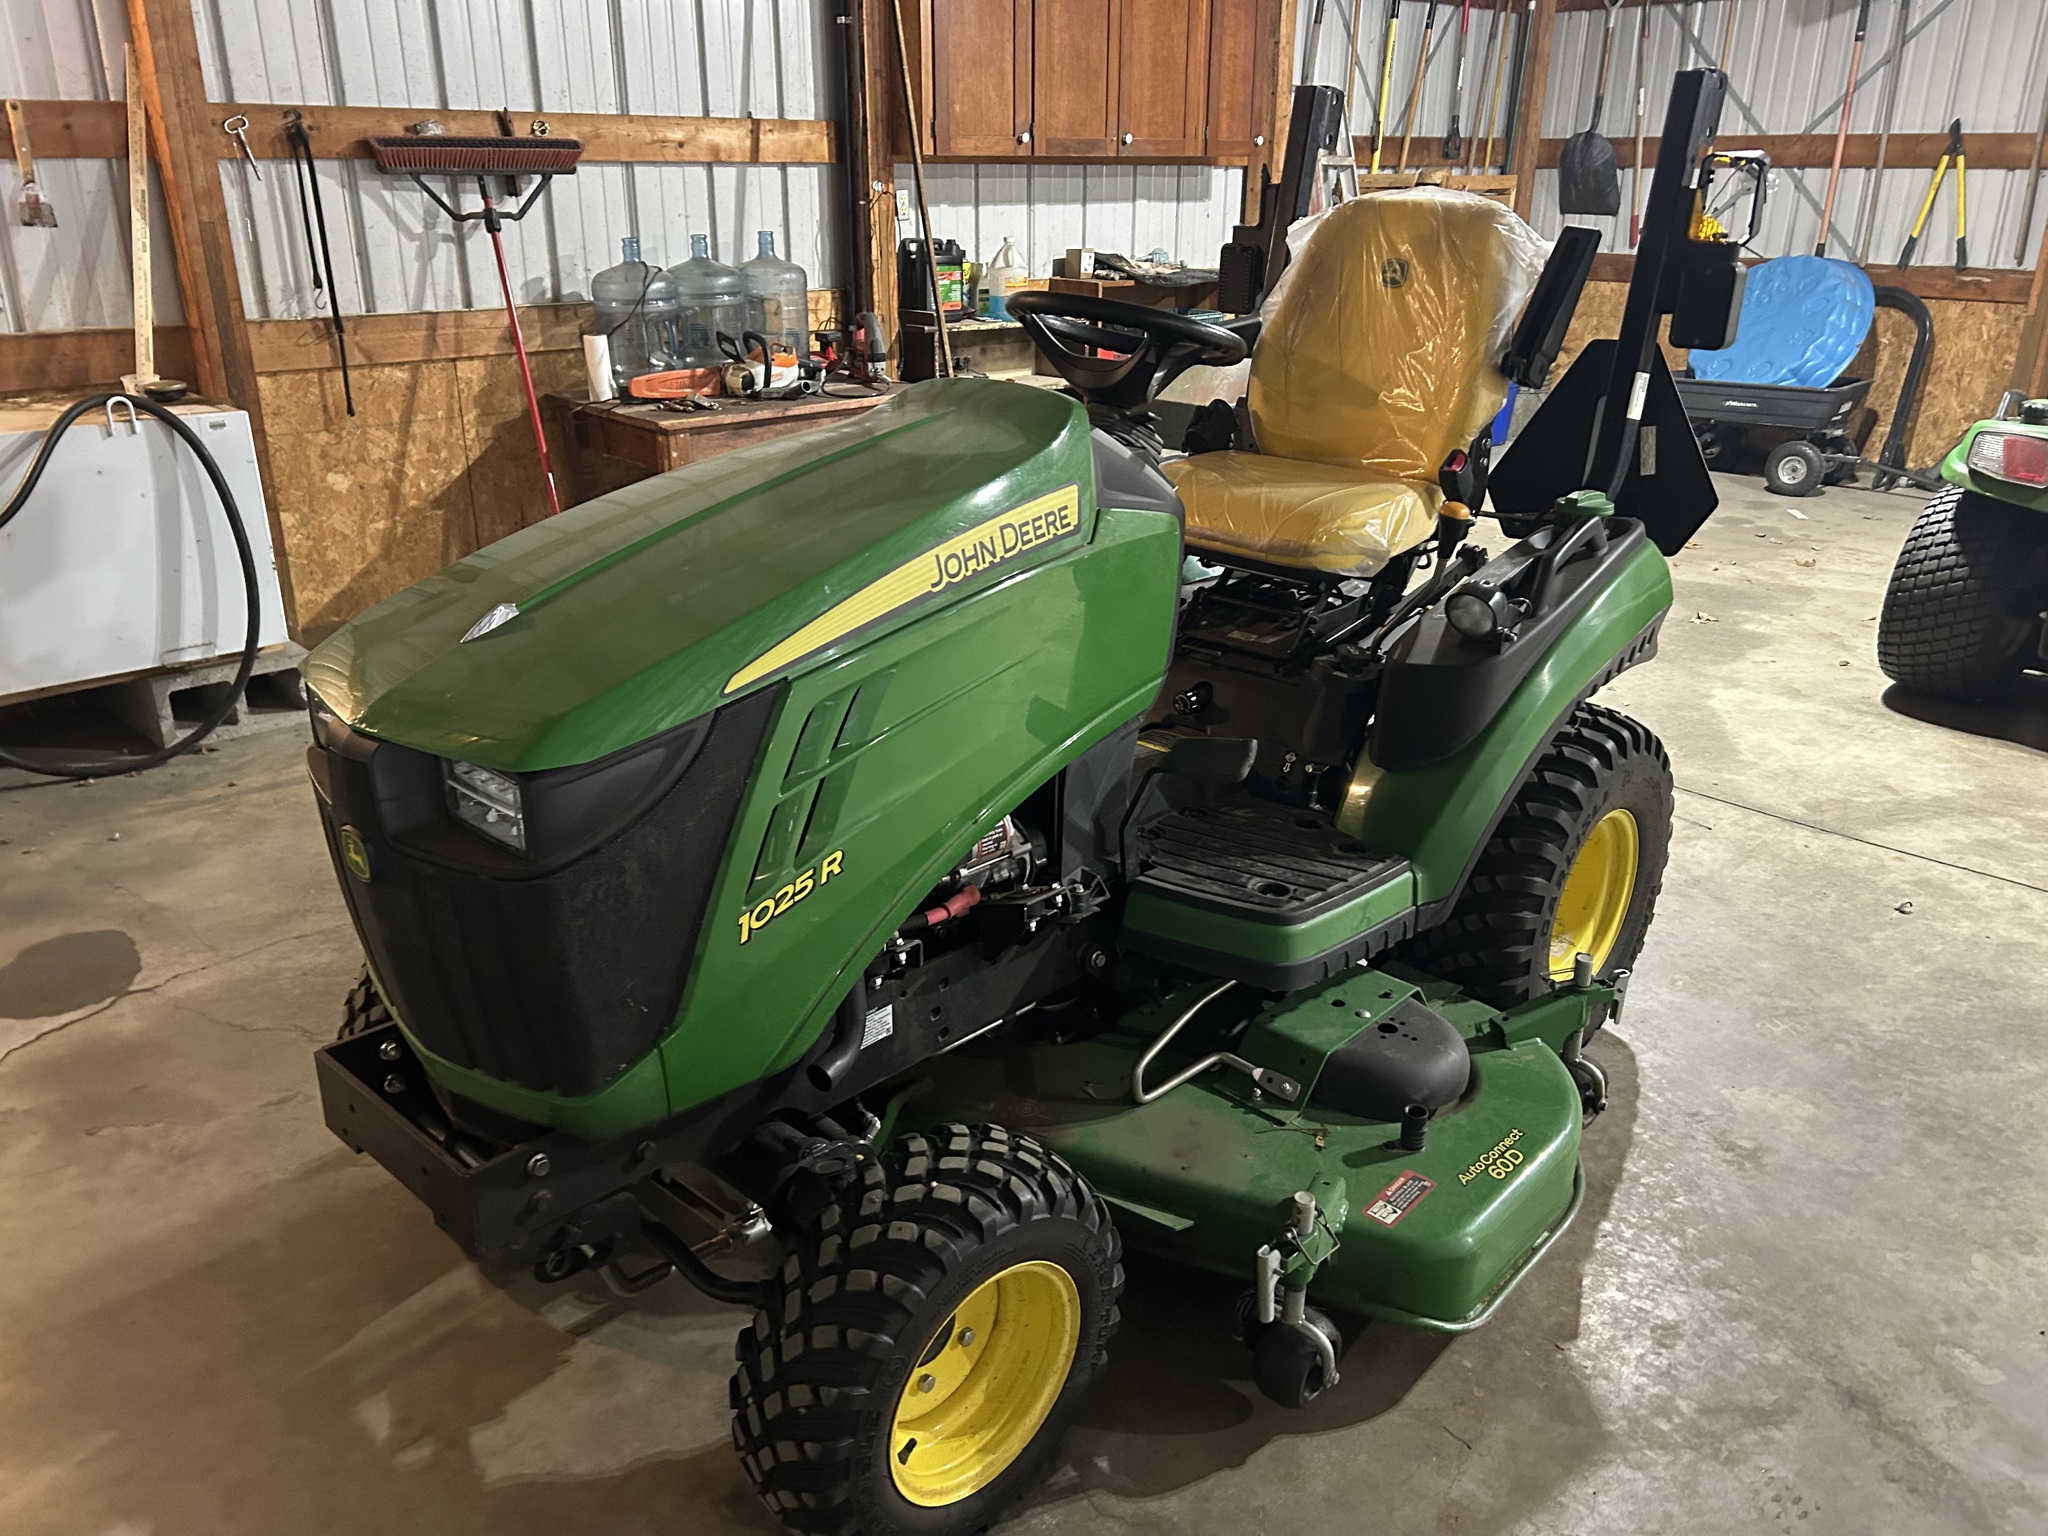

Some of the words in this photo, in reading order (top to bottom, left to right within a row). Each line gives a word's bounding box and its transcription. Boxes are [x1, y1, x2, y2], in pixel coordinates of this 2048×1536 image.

[930, 536, 998, 589] JOHN
[999, 505, 1072, 554] DEERE
[1457, 1128, 1524, 1185] AutoConnect
[1487, 1149, 1525, 1180] 60D
